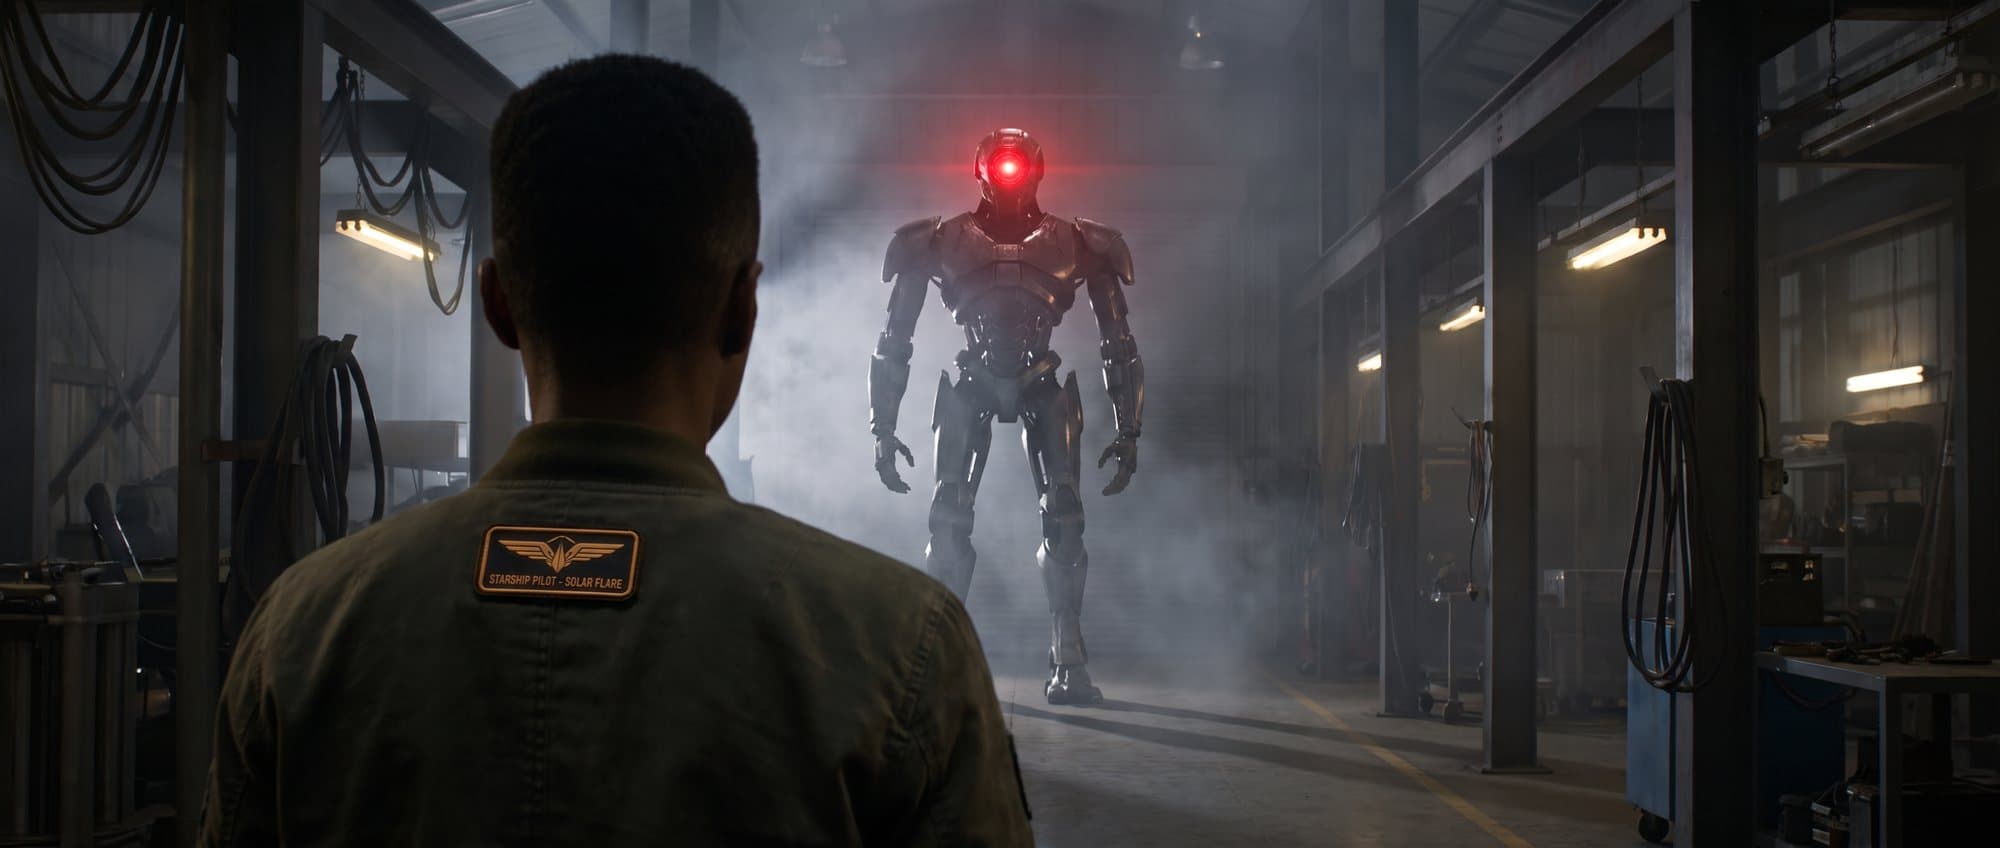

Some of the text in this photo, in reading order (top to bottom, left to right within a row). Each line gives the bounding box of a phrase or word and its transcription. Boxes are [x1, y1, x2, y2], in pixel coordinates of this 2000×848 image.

[489, 574, 530, 585] STARSHIP
[532, 576, 556, 587] PILOT
[565, 577, 593, 588] SOLAR
[595, 578, 623, 589] FLARE
